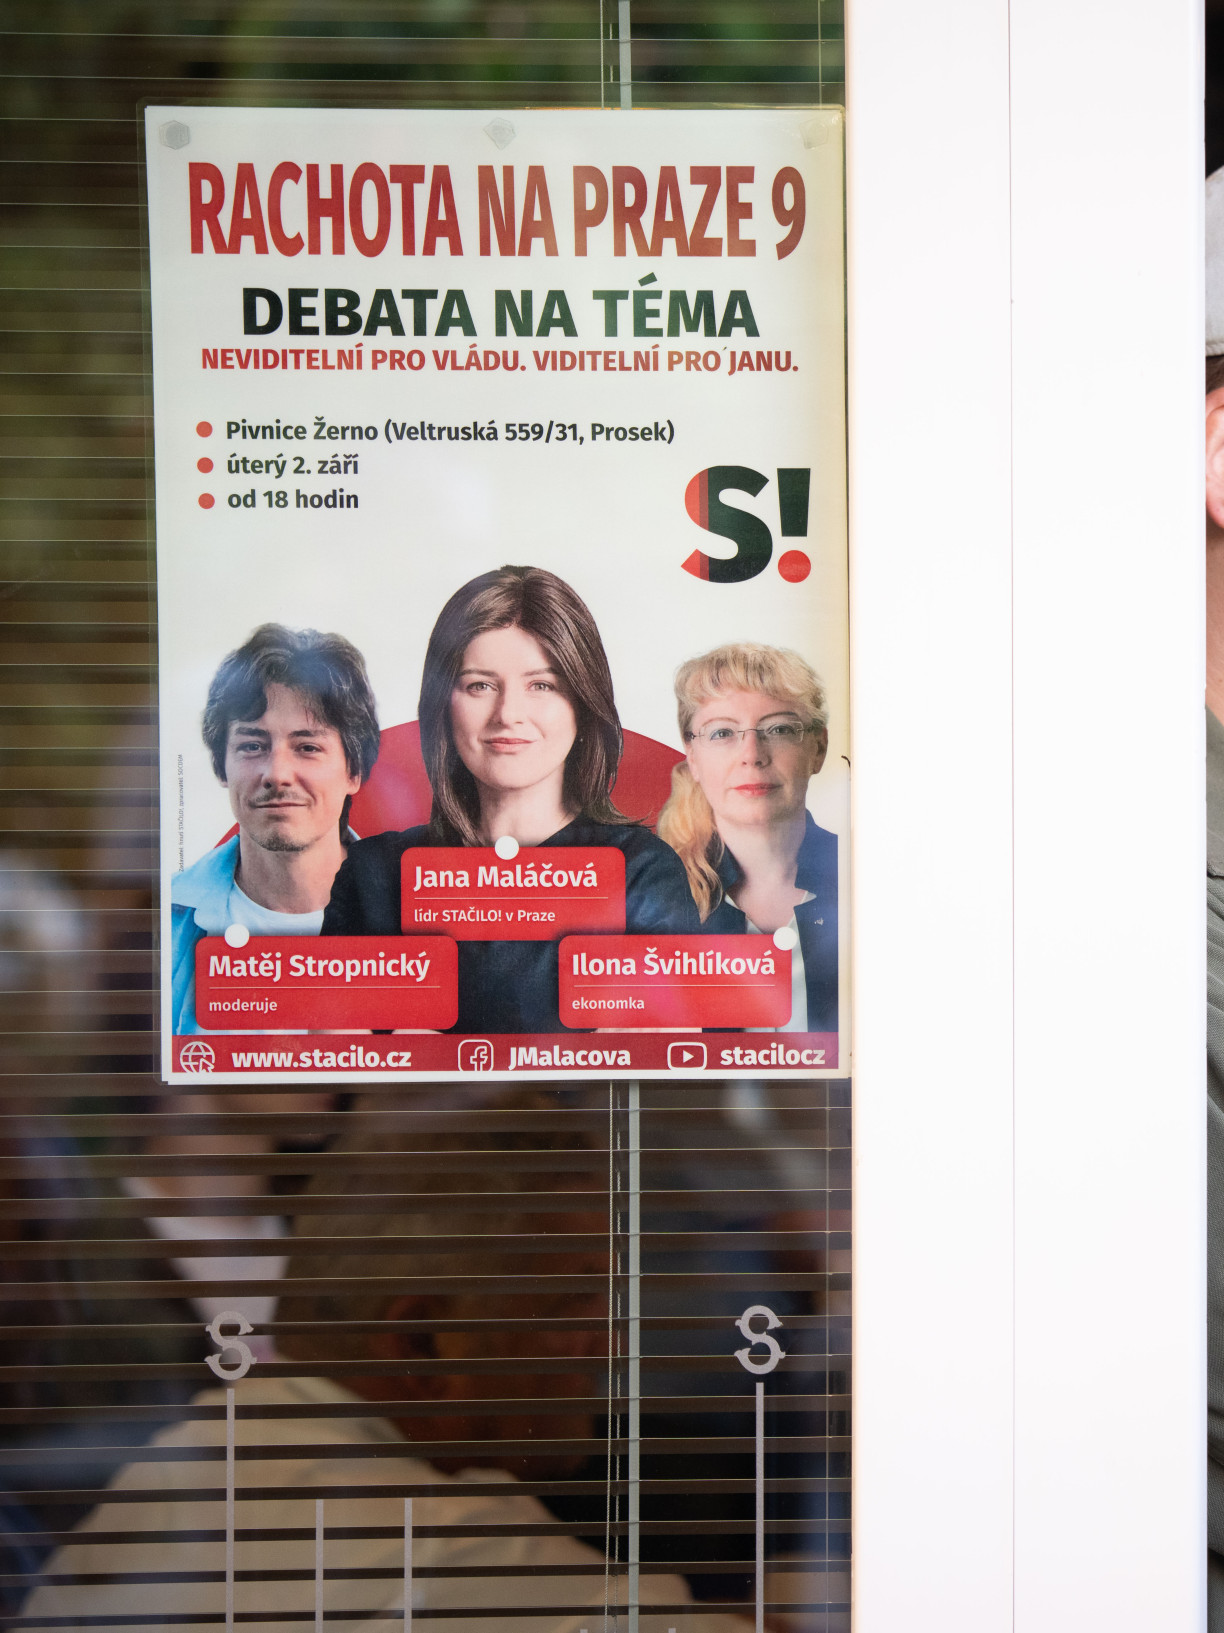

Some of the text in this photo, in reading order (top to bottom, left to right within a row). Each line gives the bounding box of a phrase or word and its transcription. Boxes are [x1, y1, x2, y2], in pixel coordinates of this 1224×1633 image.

[188, 161, 806, 260] RACHOTA NA PRAZE 9
[243, 272, 760, 338] DEBATA NA TÉMA
[202, 343, 799, 376] NEVIDITELNÍ PRO VLÁDU. VIDITELNÍ PRO JANU.
[227, 416, 674, 445] Pivnice Žerno (Veltruská 559/31, Prosek)
[228, 453, 358, 479] úterý 2. září
[228, 488, 358, 508] od 18 hodin
[413, 861, 598, 891] Jana Maláčová
[415, 907, 555, 922] lídr STAČILO! v Praze
[208, 951, 430, 983] Matěj Stropnický
[573, 949, 775, 976] Ilona Švihlíková
[209, 998, 277, 1013] moderuje
[572, 997, 644, 1009] ekonomka
[231, 1044, 412, 1068] www.stacilo.cz
[508, 1045, 632, 1070] JMalacova
[720, 1042, 826, 1066] stacilocz
